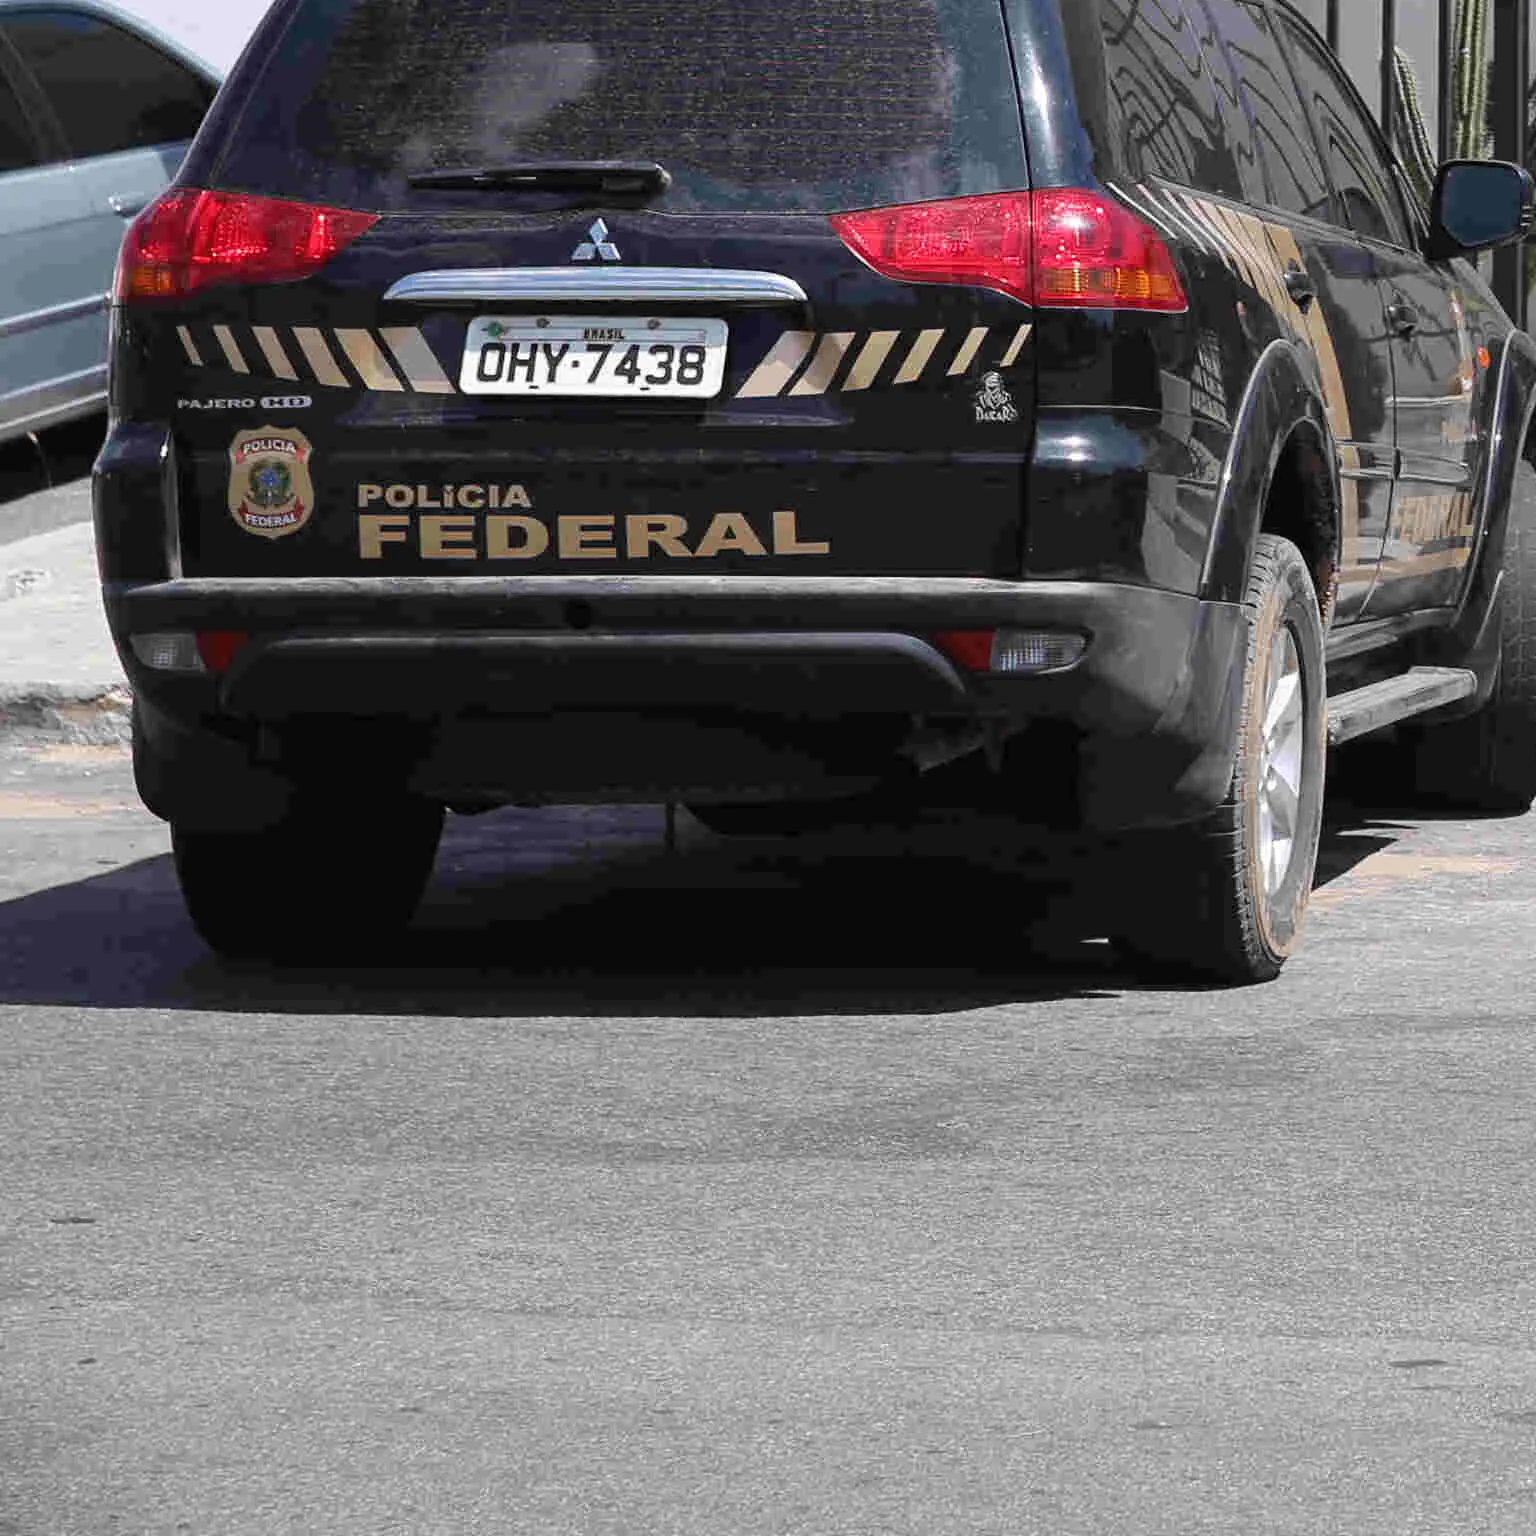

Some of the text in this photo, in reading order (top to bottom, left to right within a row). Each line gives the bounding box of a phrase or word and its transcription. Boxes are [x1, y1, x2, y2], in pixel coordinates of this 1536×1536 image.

[177, 399, 255, 409] PAJERO
[246, 514, 297, 528] FEDERAL
[359, 511, 829, 560] FEDERAL
